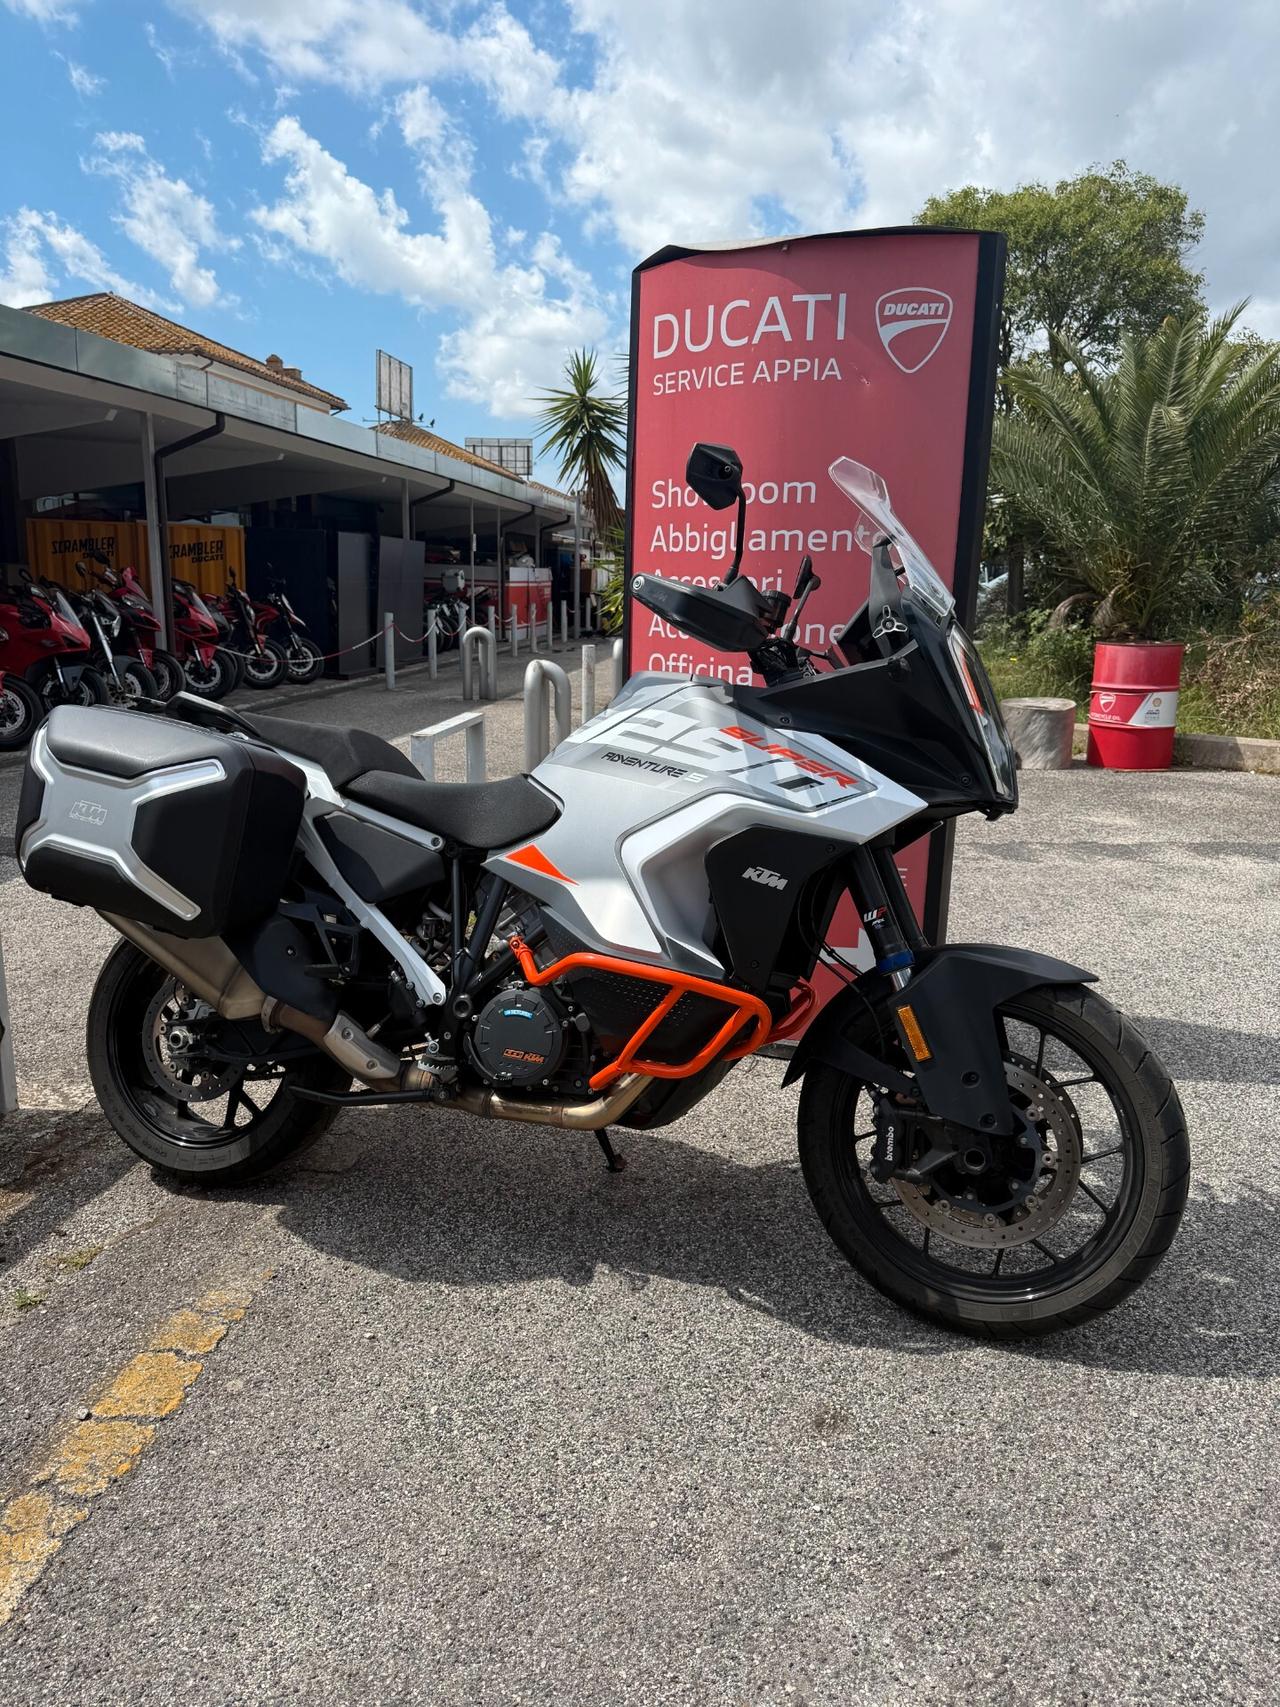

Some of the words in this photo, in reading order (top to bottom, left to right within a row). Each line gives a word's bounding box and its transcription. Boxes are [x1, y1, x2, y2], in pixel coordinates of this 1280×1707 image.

[883, 303, 944, 316] DUCATI
[653, 293, 846, 360] DUCATI
[652, 362, 744, 396] SERVICE
[752, 358, 842, 384] APPIA
[652, 479, 816, 509] Shooom
[52, 536, 114, 554] SCRAMBLER
[169, 540, 224, 559] RAMBLER
[650, 521, 888, 560] Abbiglament
[601, 751, 689, 778] ADVENTURE
[719, 725, 860, 789] SUPER
[69, 799, 108, 825] KTM
[742, 866, 788, 891] KTM
[884, 1126, 895, 1161] brembo
